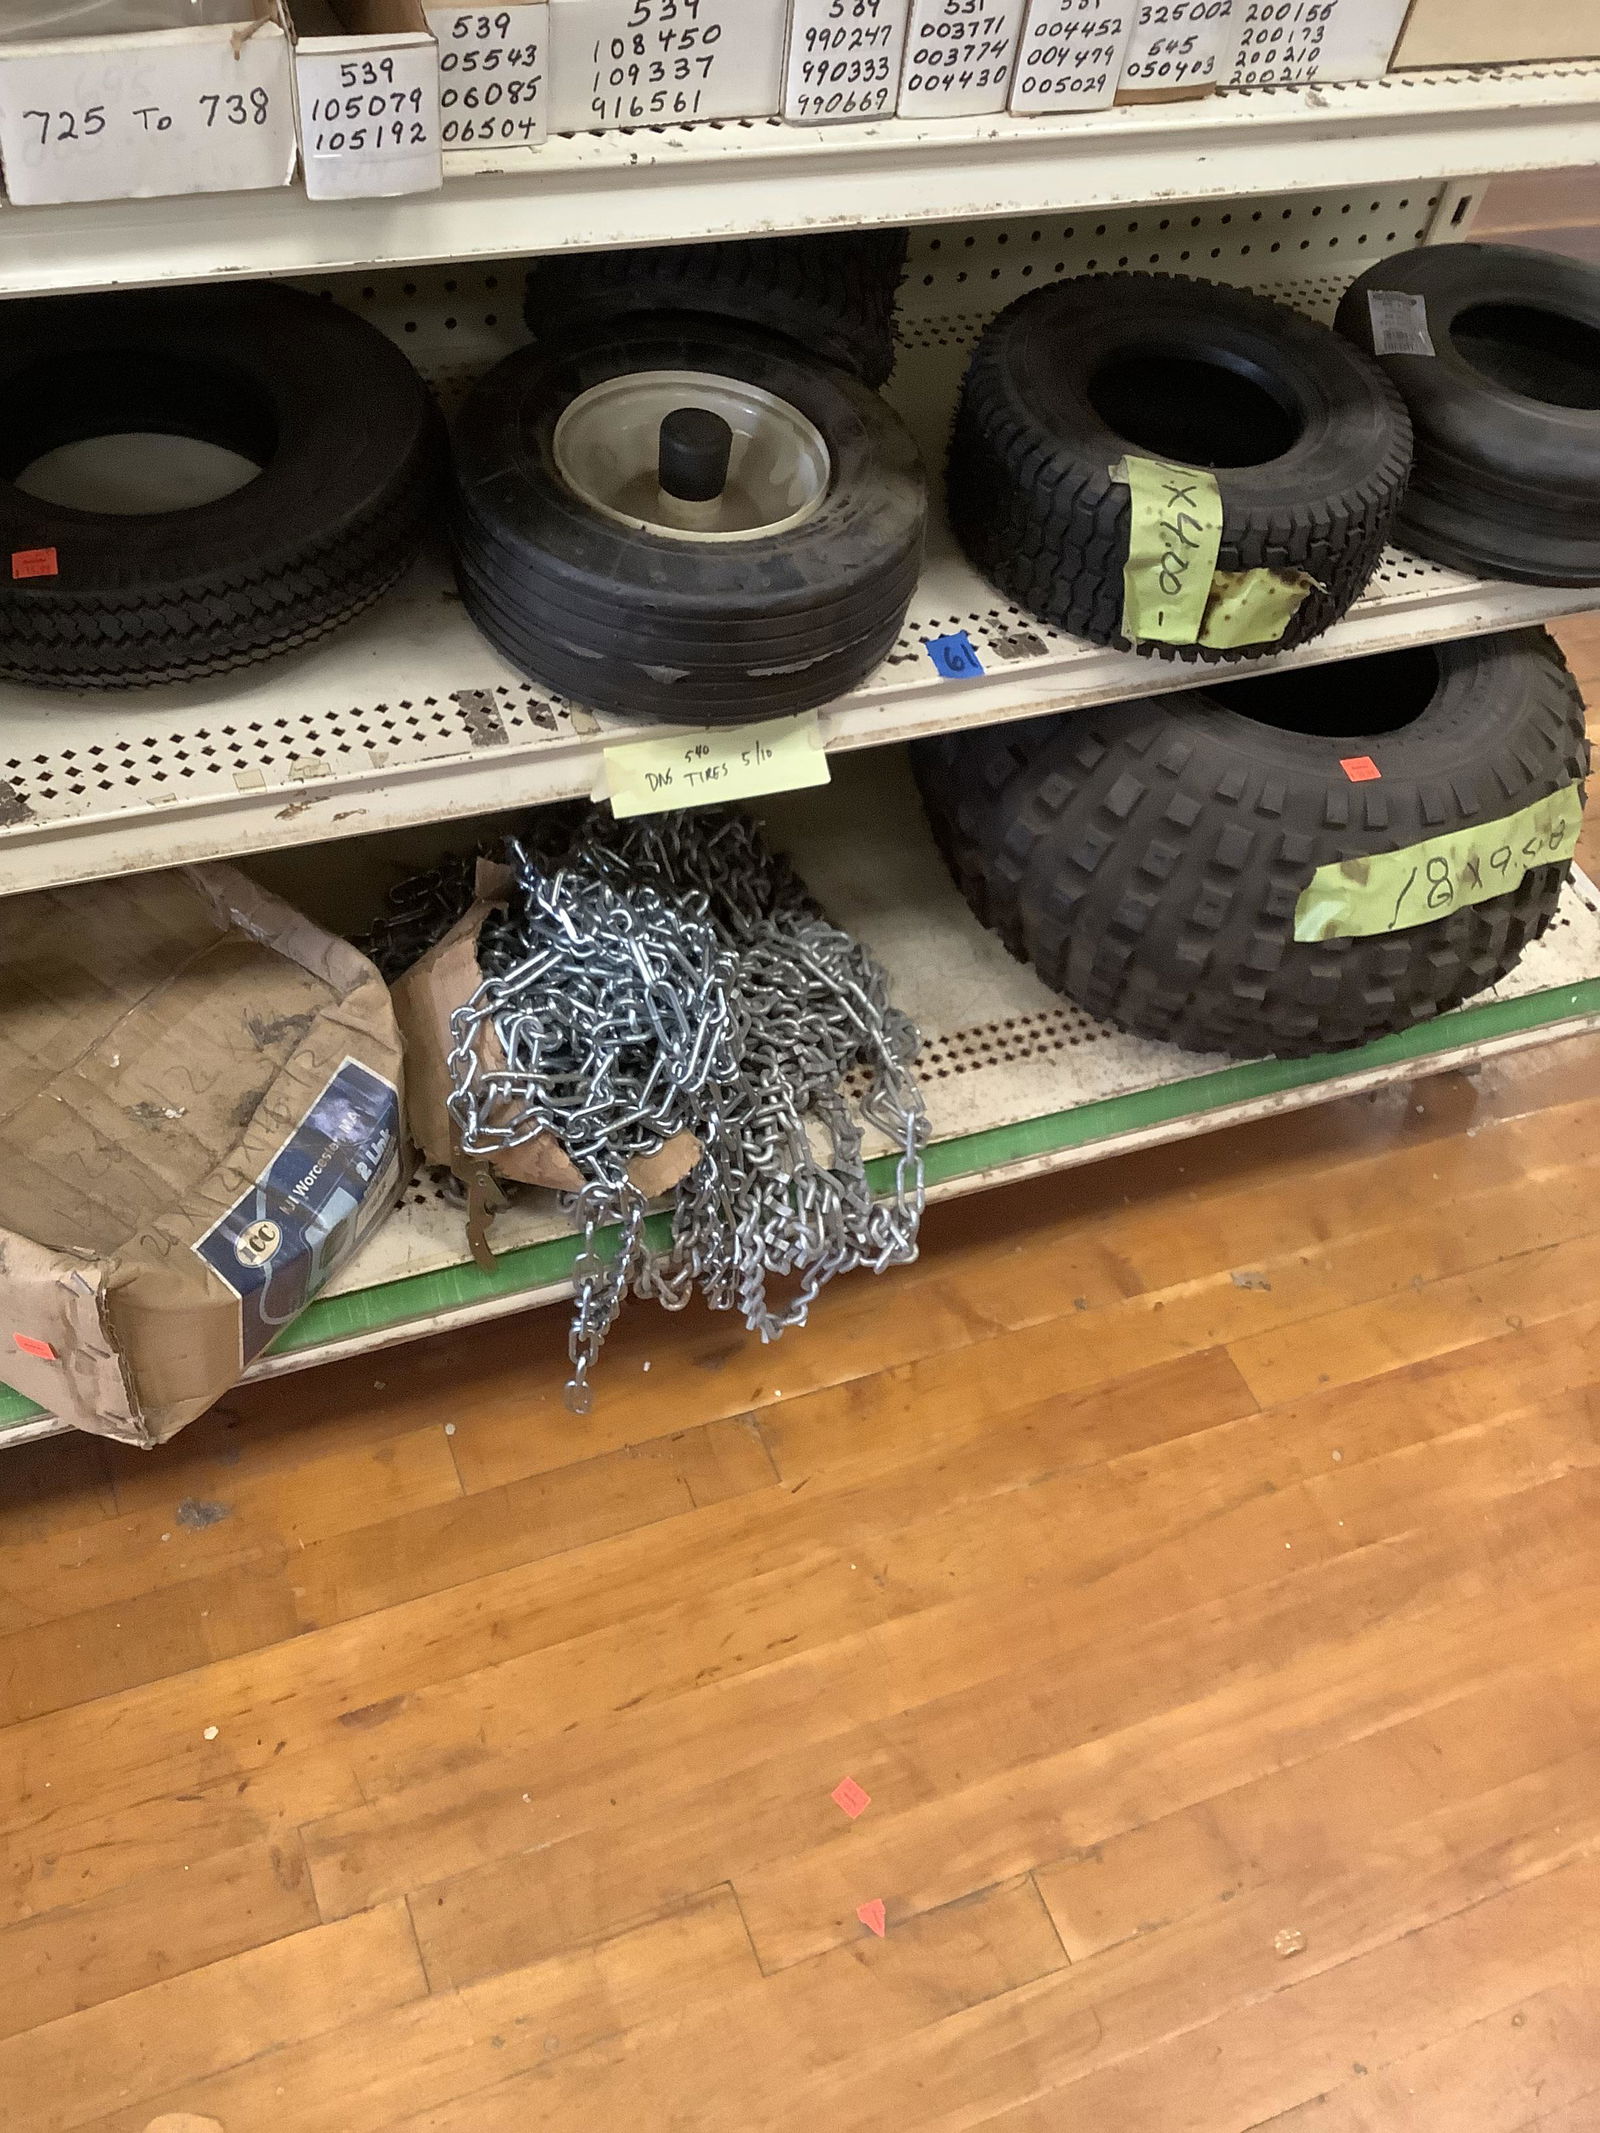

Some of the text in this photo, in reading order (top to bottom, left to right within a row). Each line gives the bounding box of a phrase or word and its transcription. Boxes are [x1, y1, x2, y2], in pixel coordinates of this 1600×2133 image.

[452, 12, 510, 39] 539
[1139, 0, 1232, 25] 325002
[594, 24, 721, 62] 108450
[806, 25, 892, 52] 990247
[1035, 18, 1121, 41] 004452
[1027, 45, 1114, 68] 004479
[1148, 35, 1198, 56] 545
[1235, 46, 1320, 67] 200210
[341, 58, 393, 88] 539
[593, 56, 714, 92] 109337
[803, 56, 889, 86] 990333
[908, 65, 1008, 91] 004430
[1022, 73, 1106, 93] 005029
[1229, 65, 1321, 85] 200214
[312, 87, 422, 121] 105079
[592, 90, 701, 119] 916561
[799, 88, 888, 115] 990669
[23, 87, 269, 144] 725 To 738
[312, 118, 427, 150] 105192
[683, 763, 728, 787] TIRES
[741, 740, 773, 766] 5/10
[355, 1161, 372, 1182] 2
[239, 1223, 277, 1263] ICC
